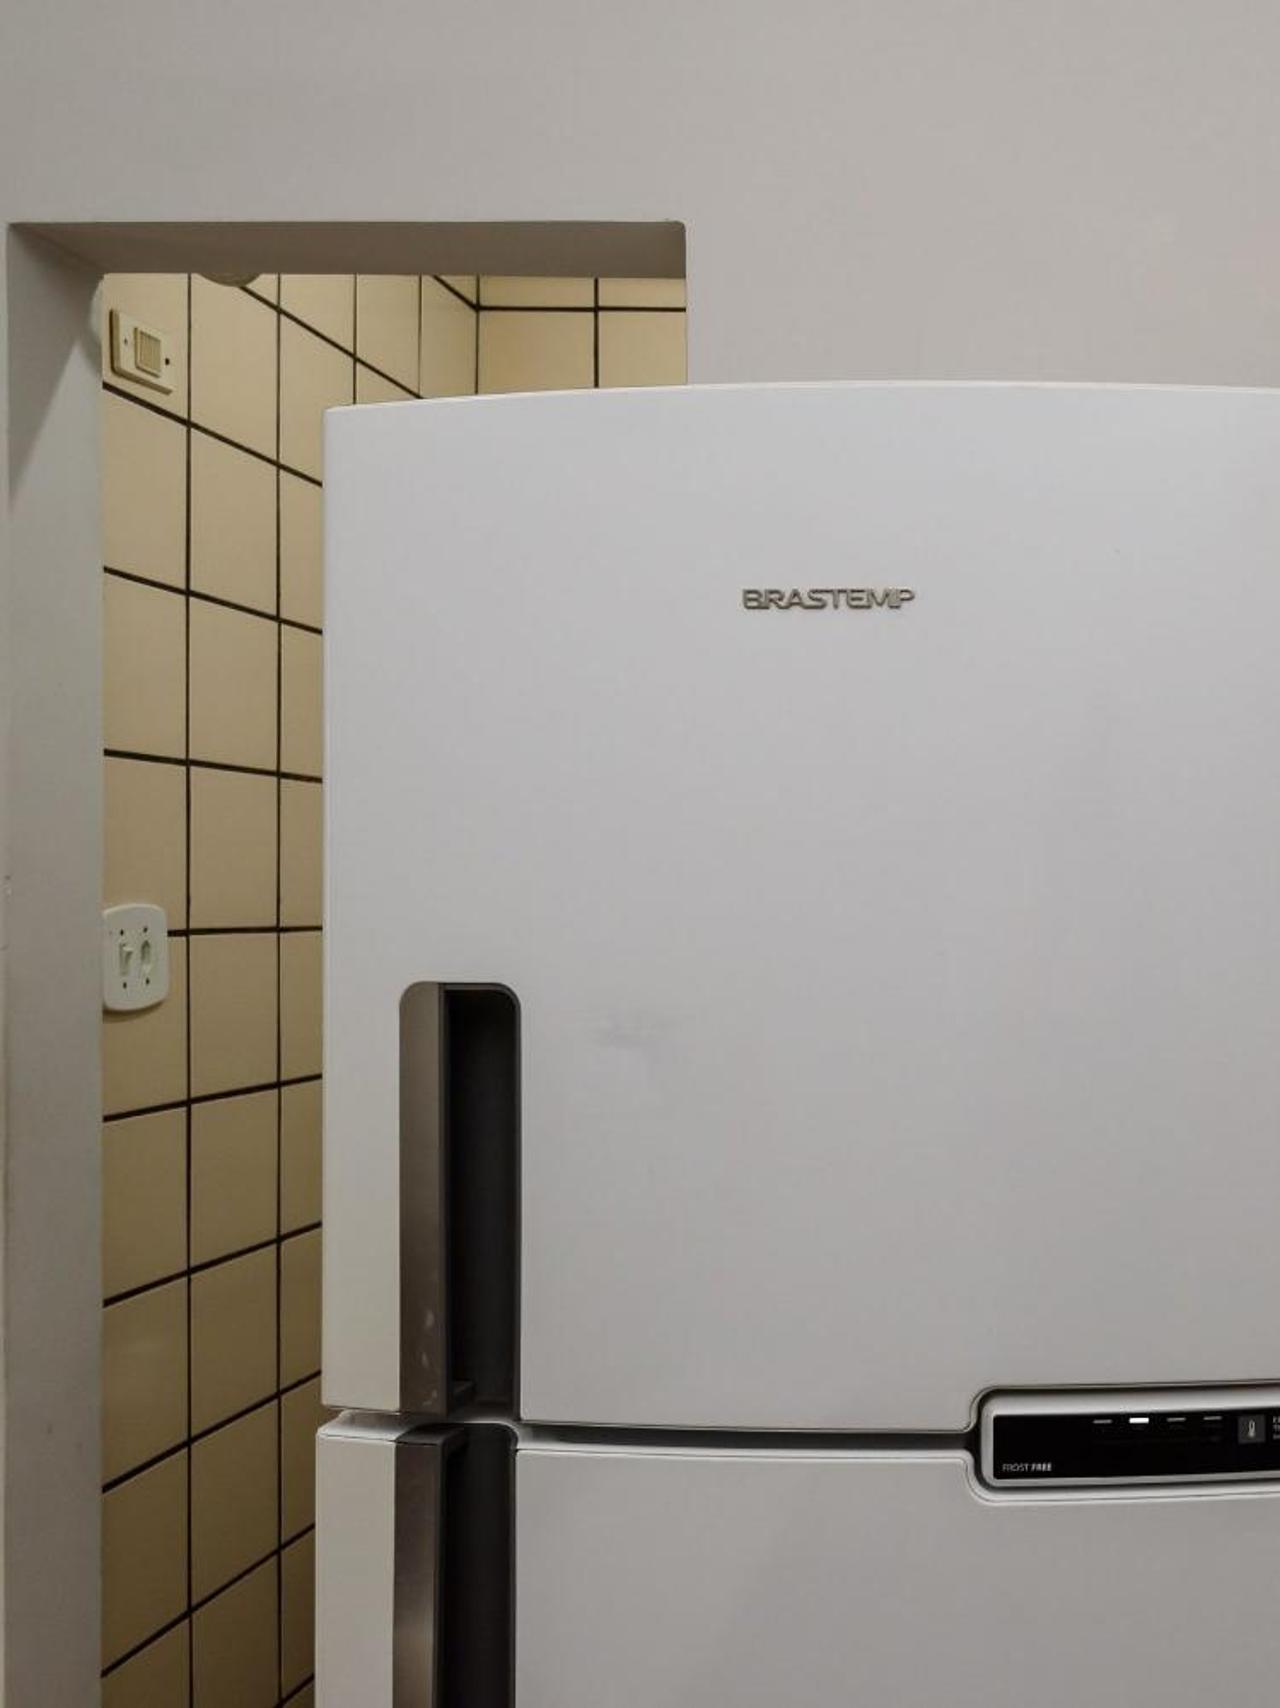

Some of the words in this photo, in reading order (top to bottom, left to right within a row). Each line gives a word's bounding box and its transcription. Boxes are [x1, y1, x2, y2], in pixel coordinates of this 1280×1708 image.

[742, 588, 916, 610] BRASTEMP
[1002, 1463, 1029, 1472] FROST
[1031, 1463, 1052, 1472] FREE
